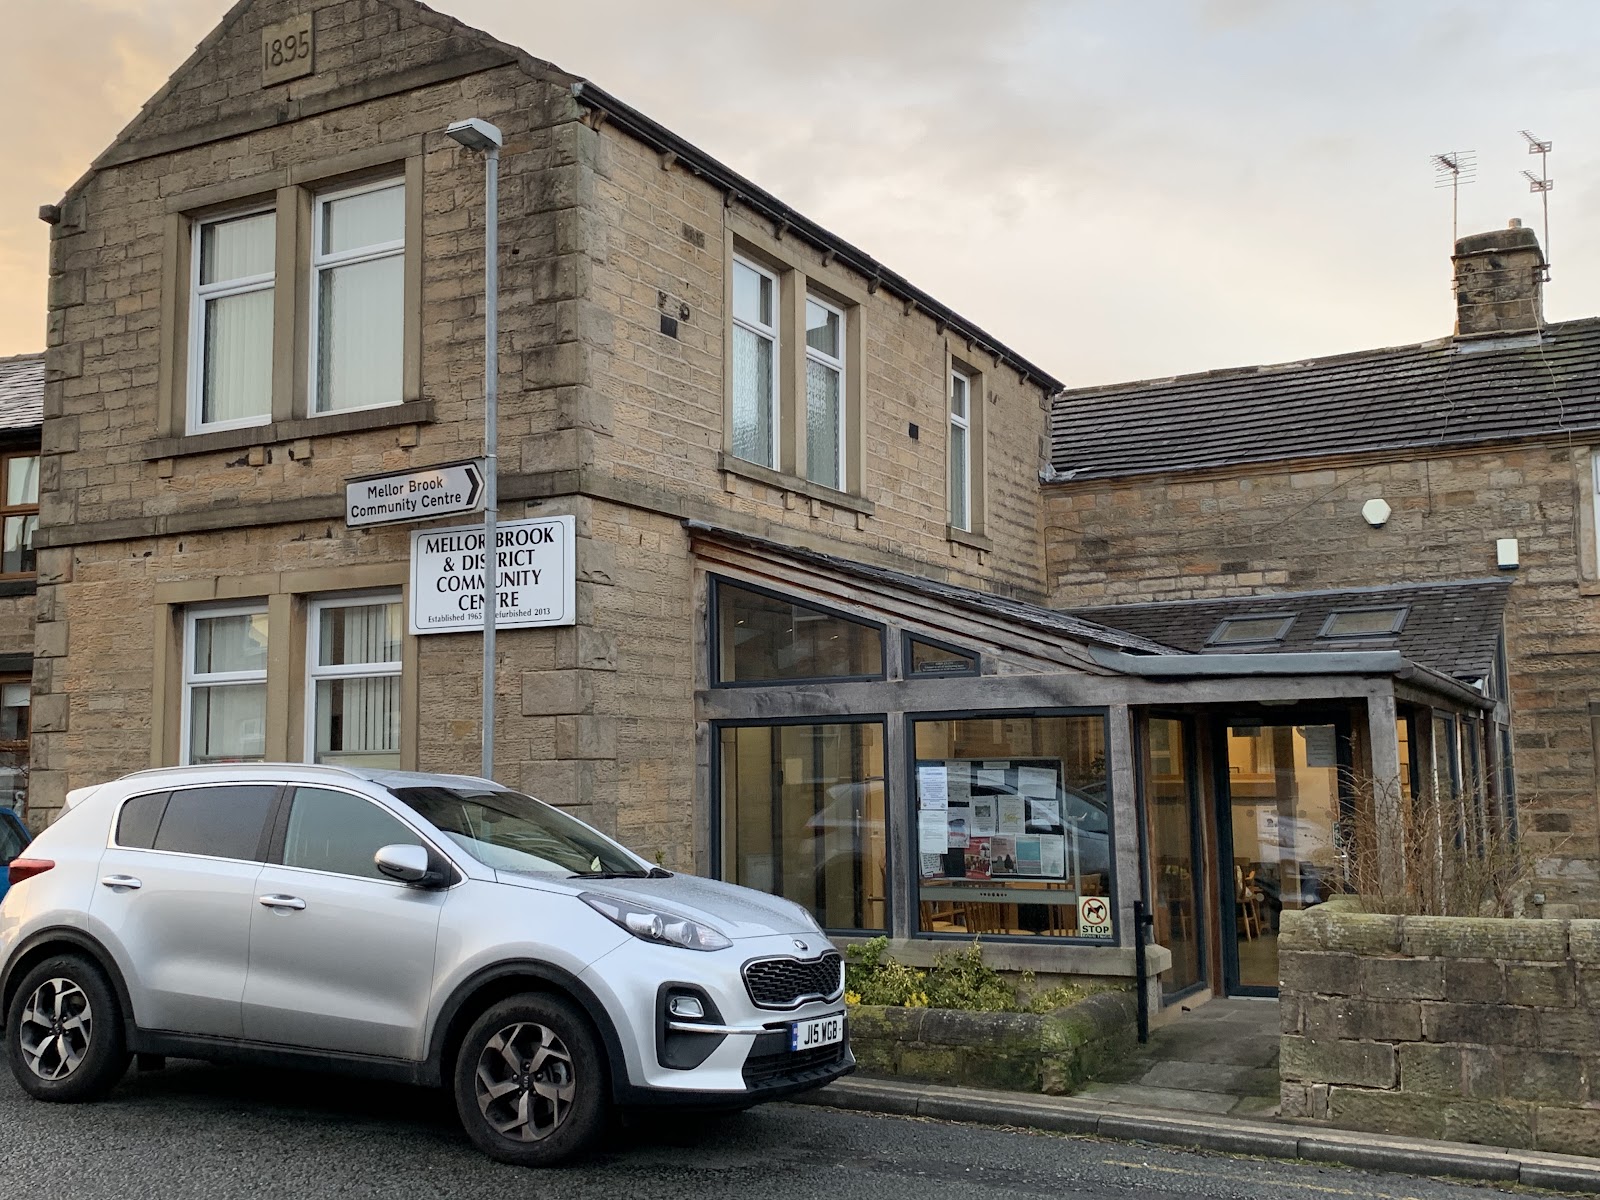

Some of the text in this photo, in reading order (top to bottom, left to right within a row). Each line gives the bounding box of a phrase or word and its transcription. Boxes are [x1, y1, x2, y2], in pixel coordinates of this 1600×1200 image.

[265, 30, 309, 70] 1895
[368, 476, 443, 499] Mellor Brook
[351, 492, 461, 518] Community Centre
[425, 527, 554, 554] MELLOR BROOK
[443, 549, 535, 572] & DISRICT
[428, 608, 551, 623] Established 1965 efurbished 2013
[1082, 925, 1109, 933] STOP
[804, 1023, 819, 1045] J15
